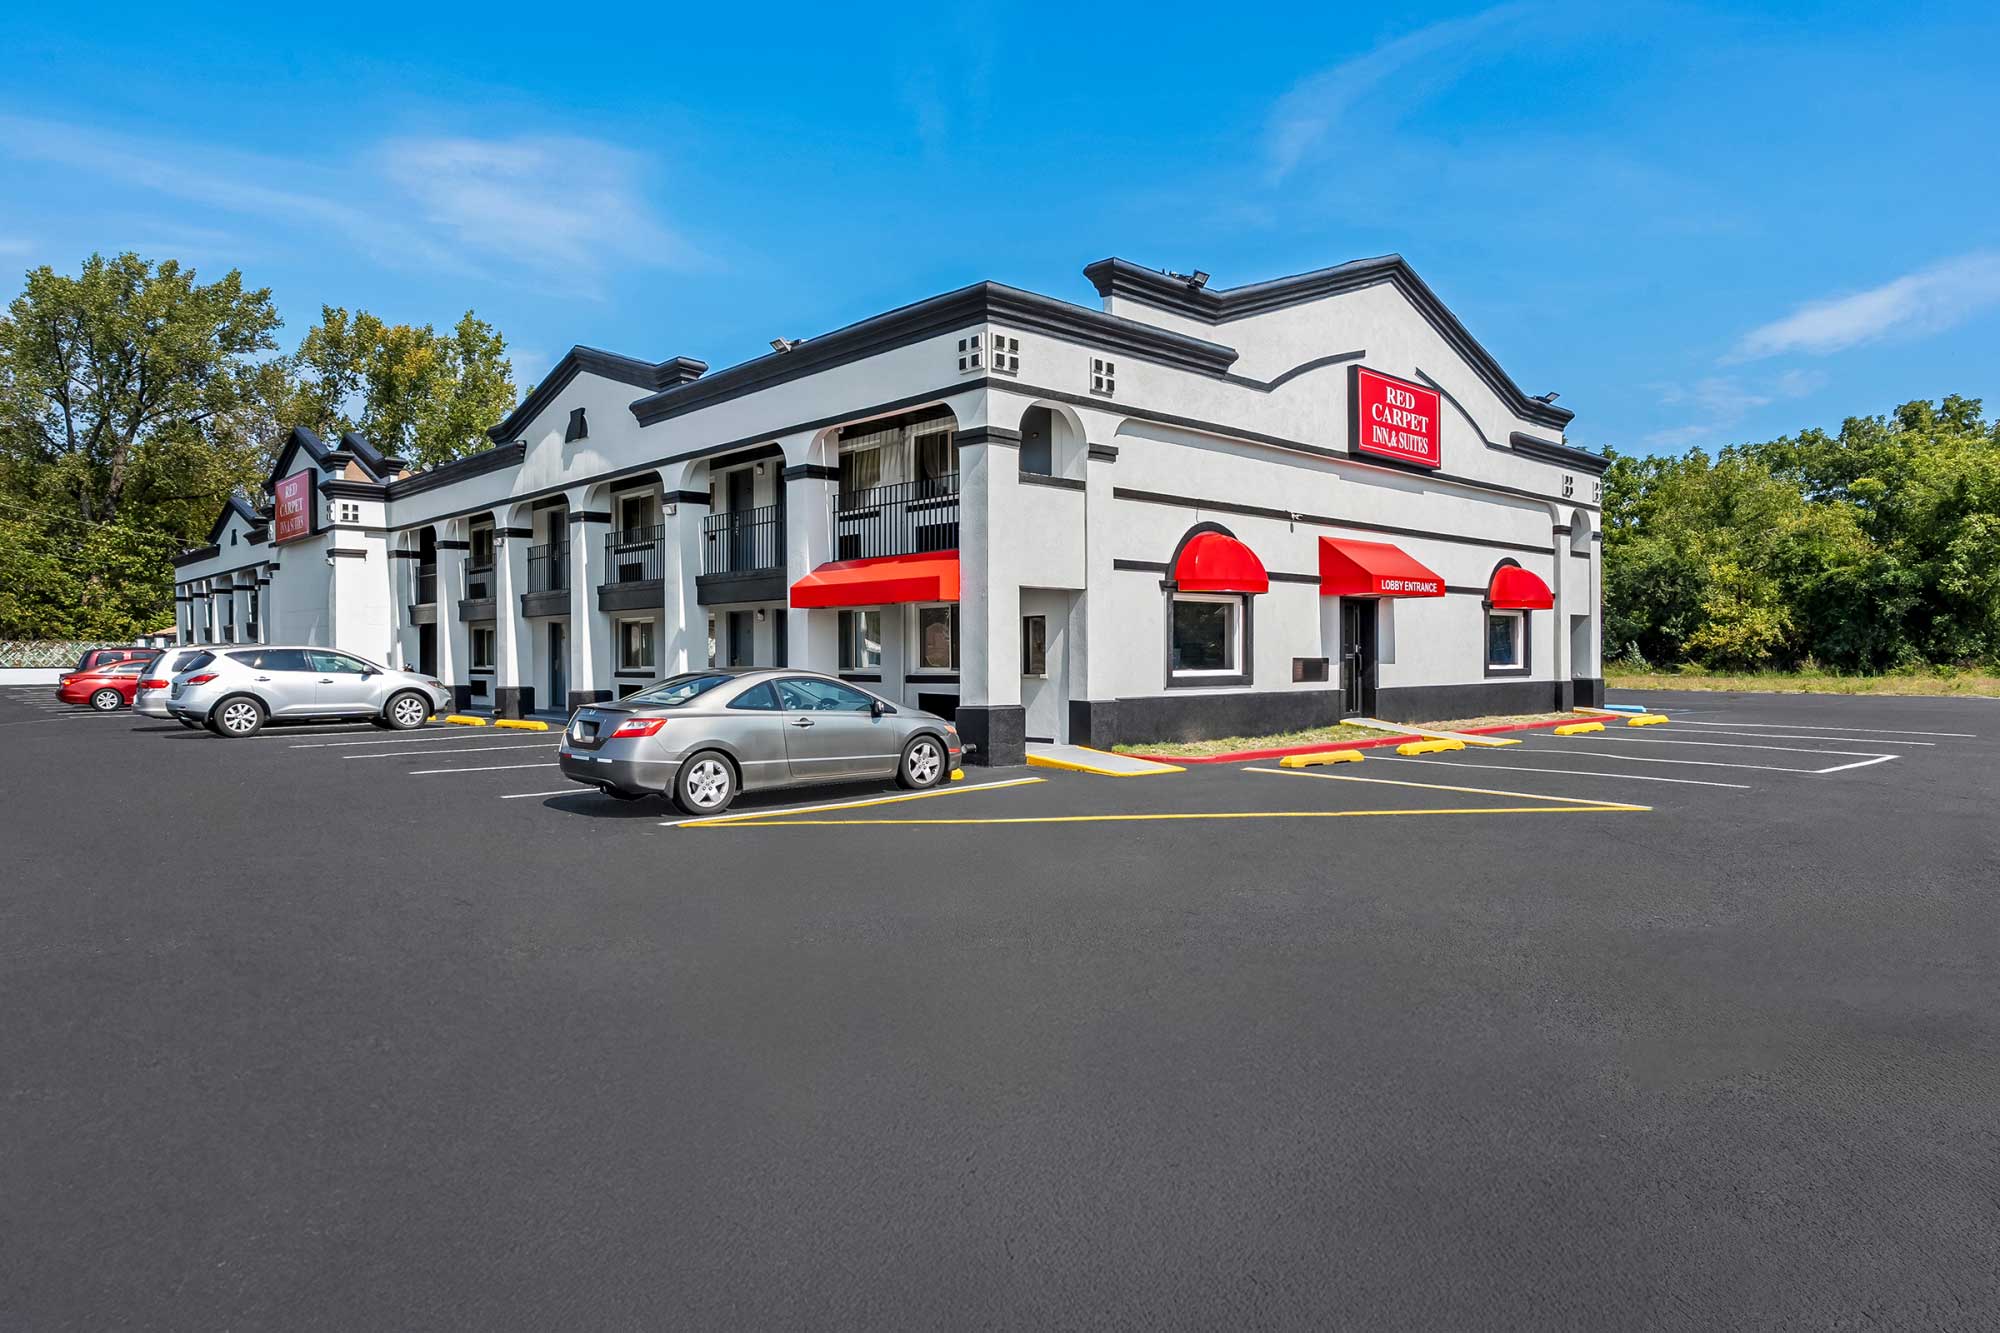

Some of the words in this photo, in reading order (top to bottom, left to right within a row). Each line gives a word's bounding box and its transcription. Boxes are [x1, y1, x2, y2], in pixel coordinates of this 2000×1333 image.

[1386, 386, 1416, 410] RED
[1372, 403, 1429, 433] CARPET
[1391, 430, 1397, 447] &
[1398, 431, 1429, 455] SUITES
[279, 497, 304, 518] CARPET
[1381, 579, 1404, 591] LOBBY
[1404, 581, 1438, 593] ENTRANCE
